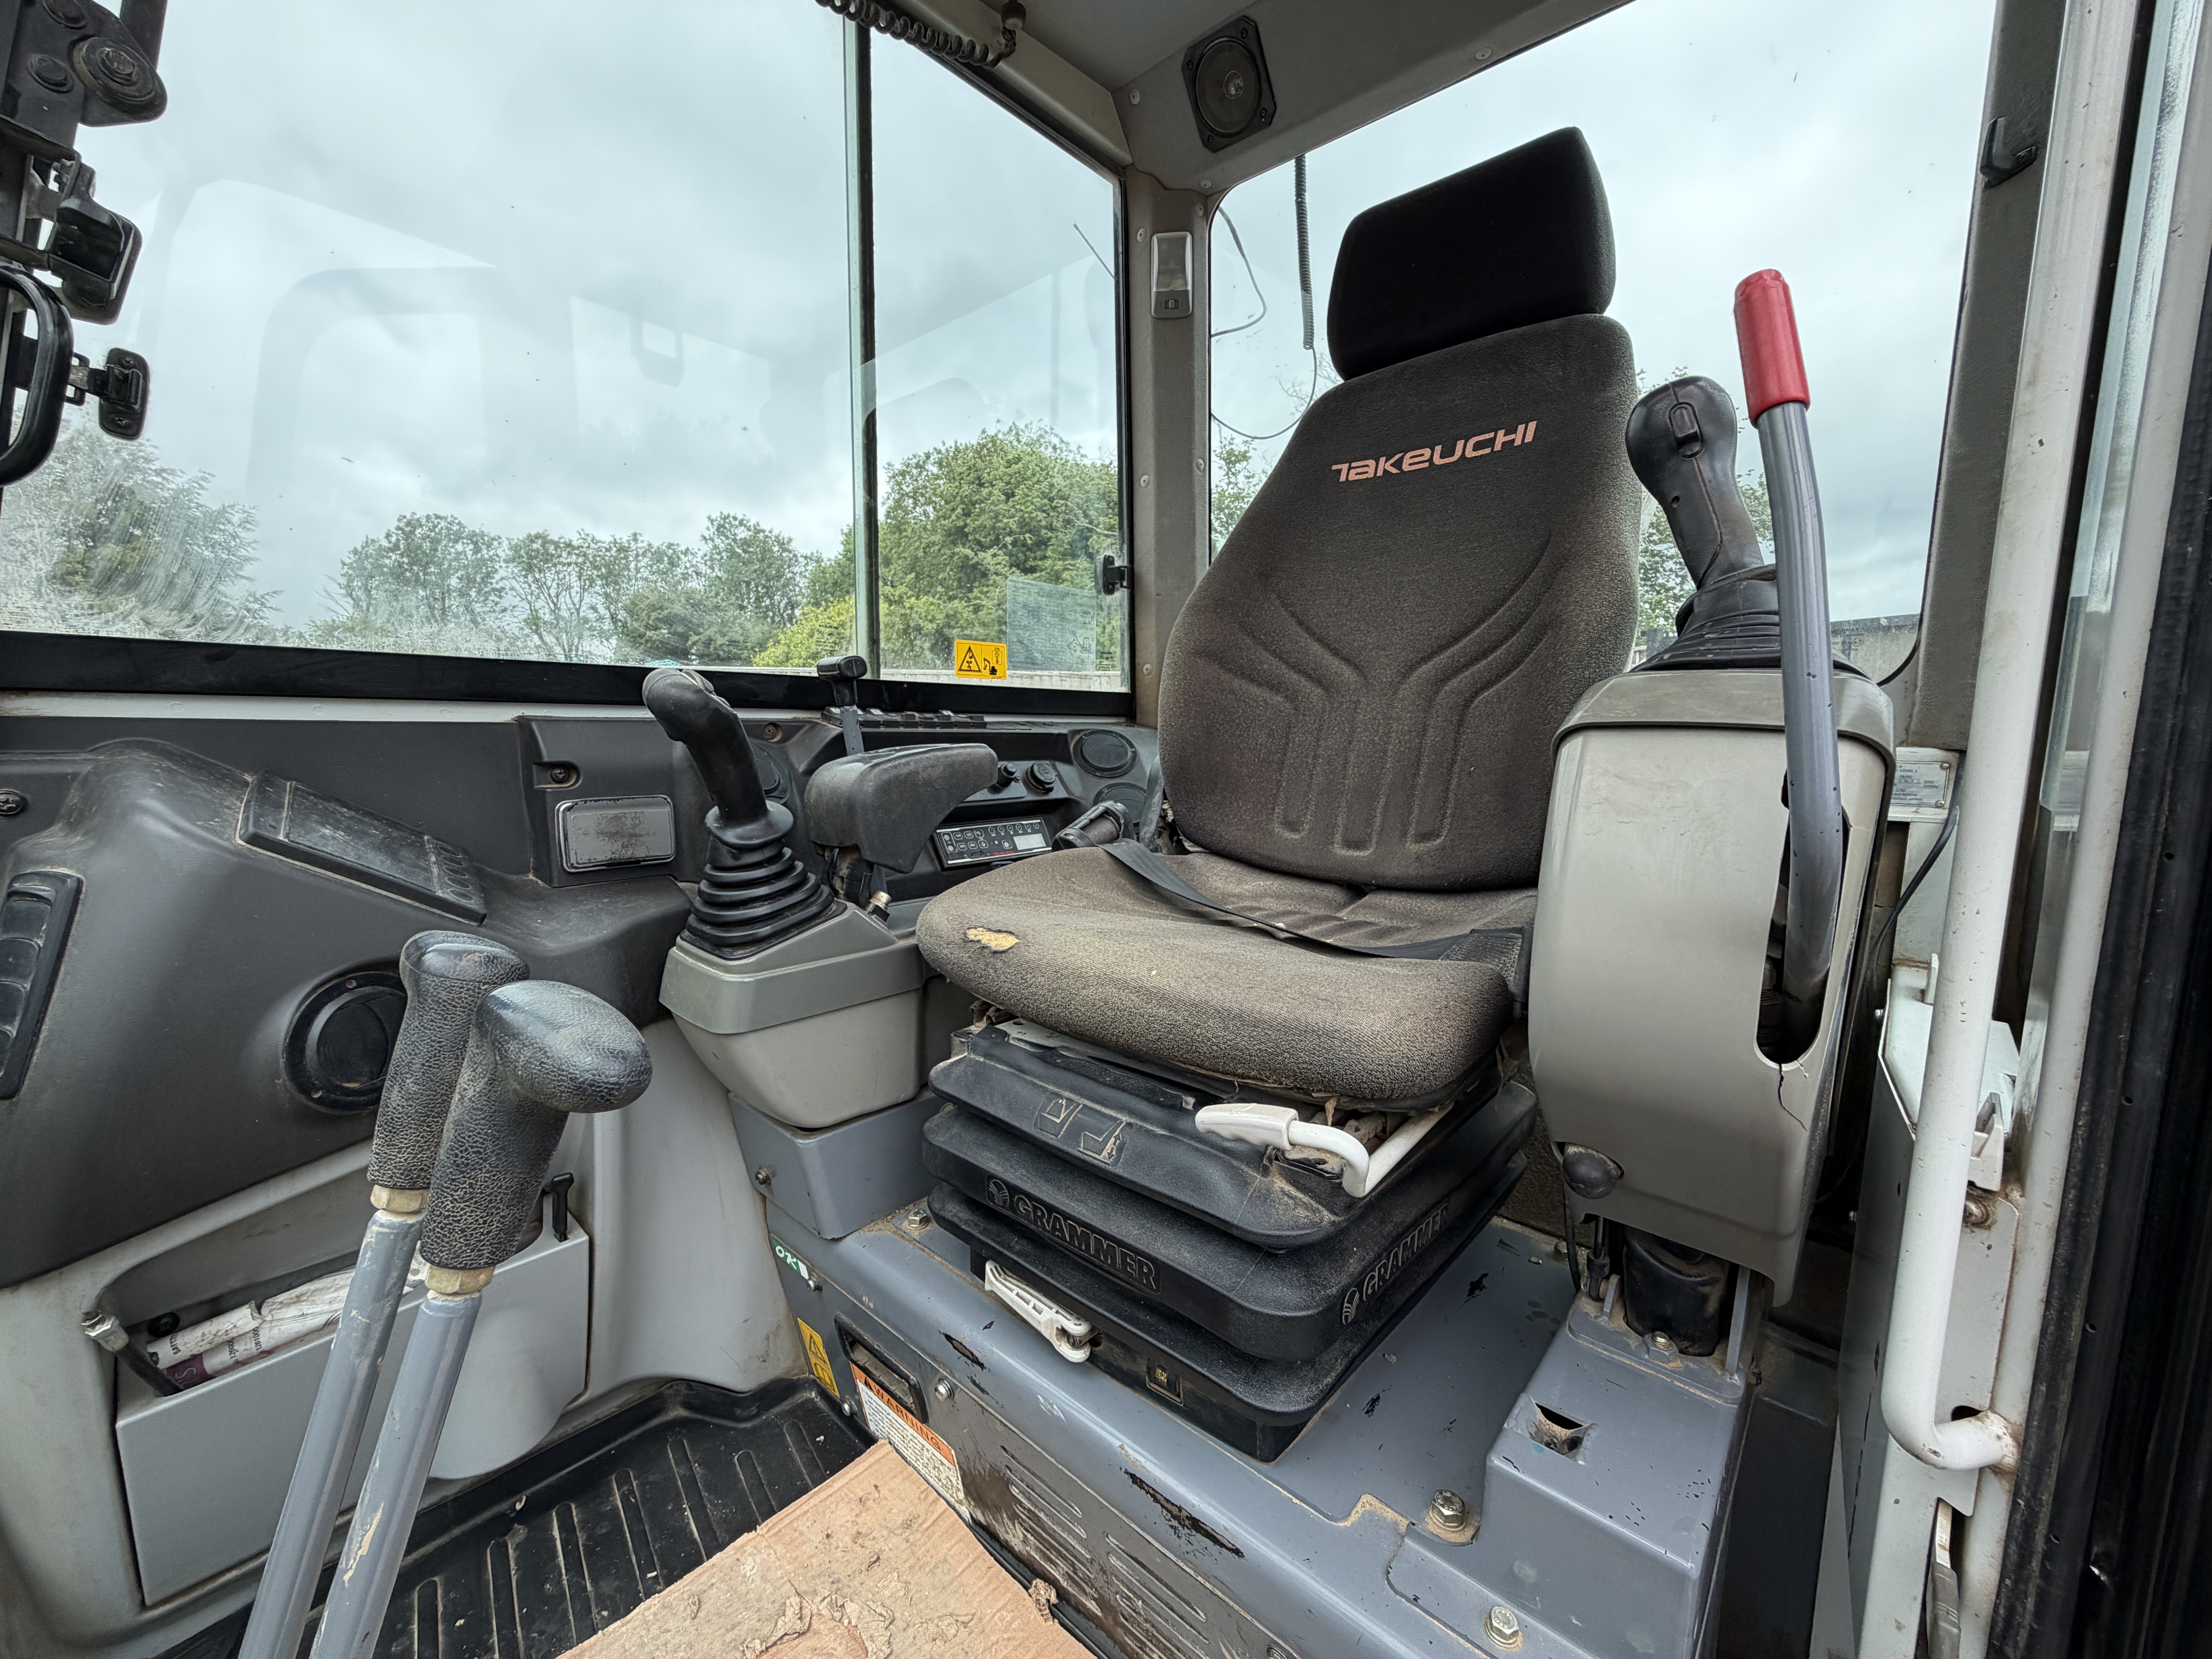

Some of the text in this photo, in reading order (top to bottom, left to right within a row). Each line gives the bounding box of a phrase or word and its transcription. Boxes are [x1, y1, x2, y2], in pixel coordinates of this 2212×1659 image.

[1331, 421, 1537, 482] TAKEUCHI
[1014, 1195, 1156, 1290] GRAMMER
[1362, 1203, 1449, 1301] GRAMMER
[874, 1386, 941, 1451] WARNING
